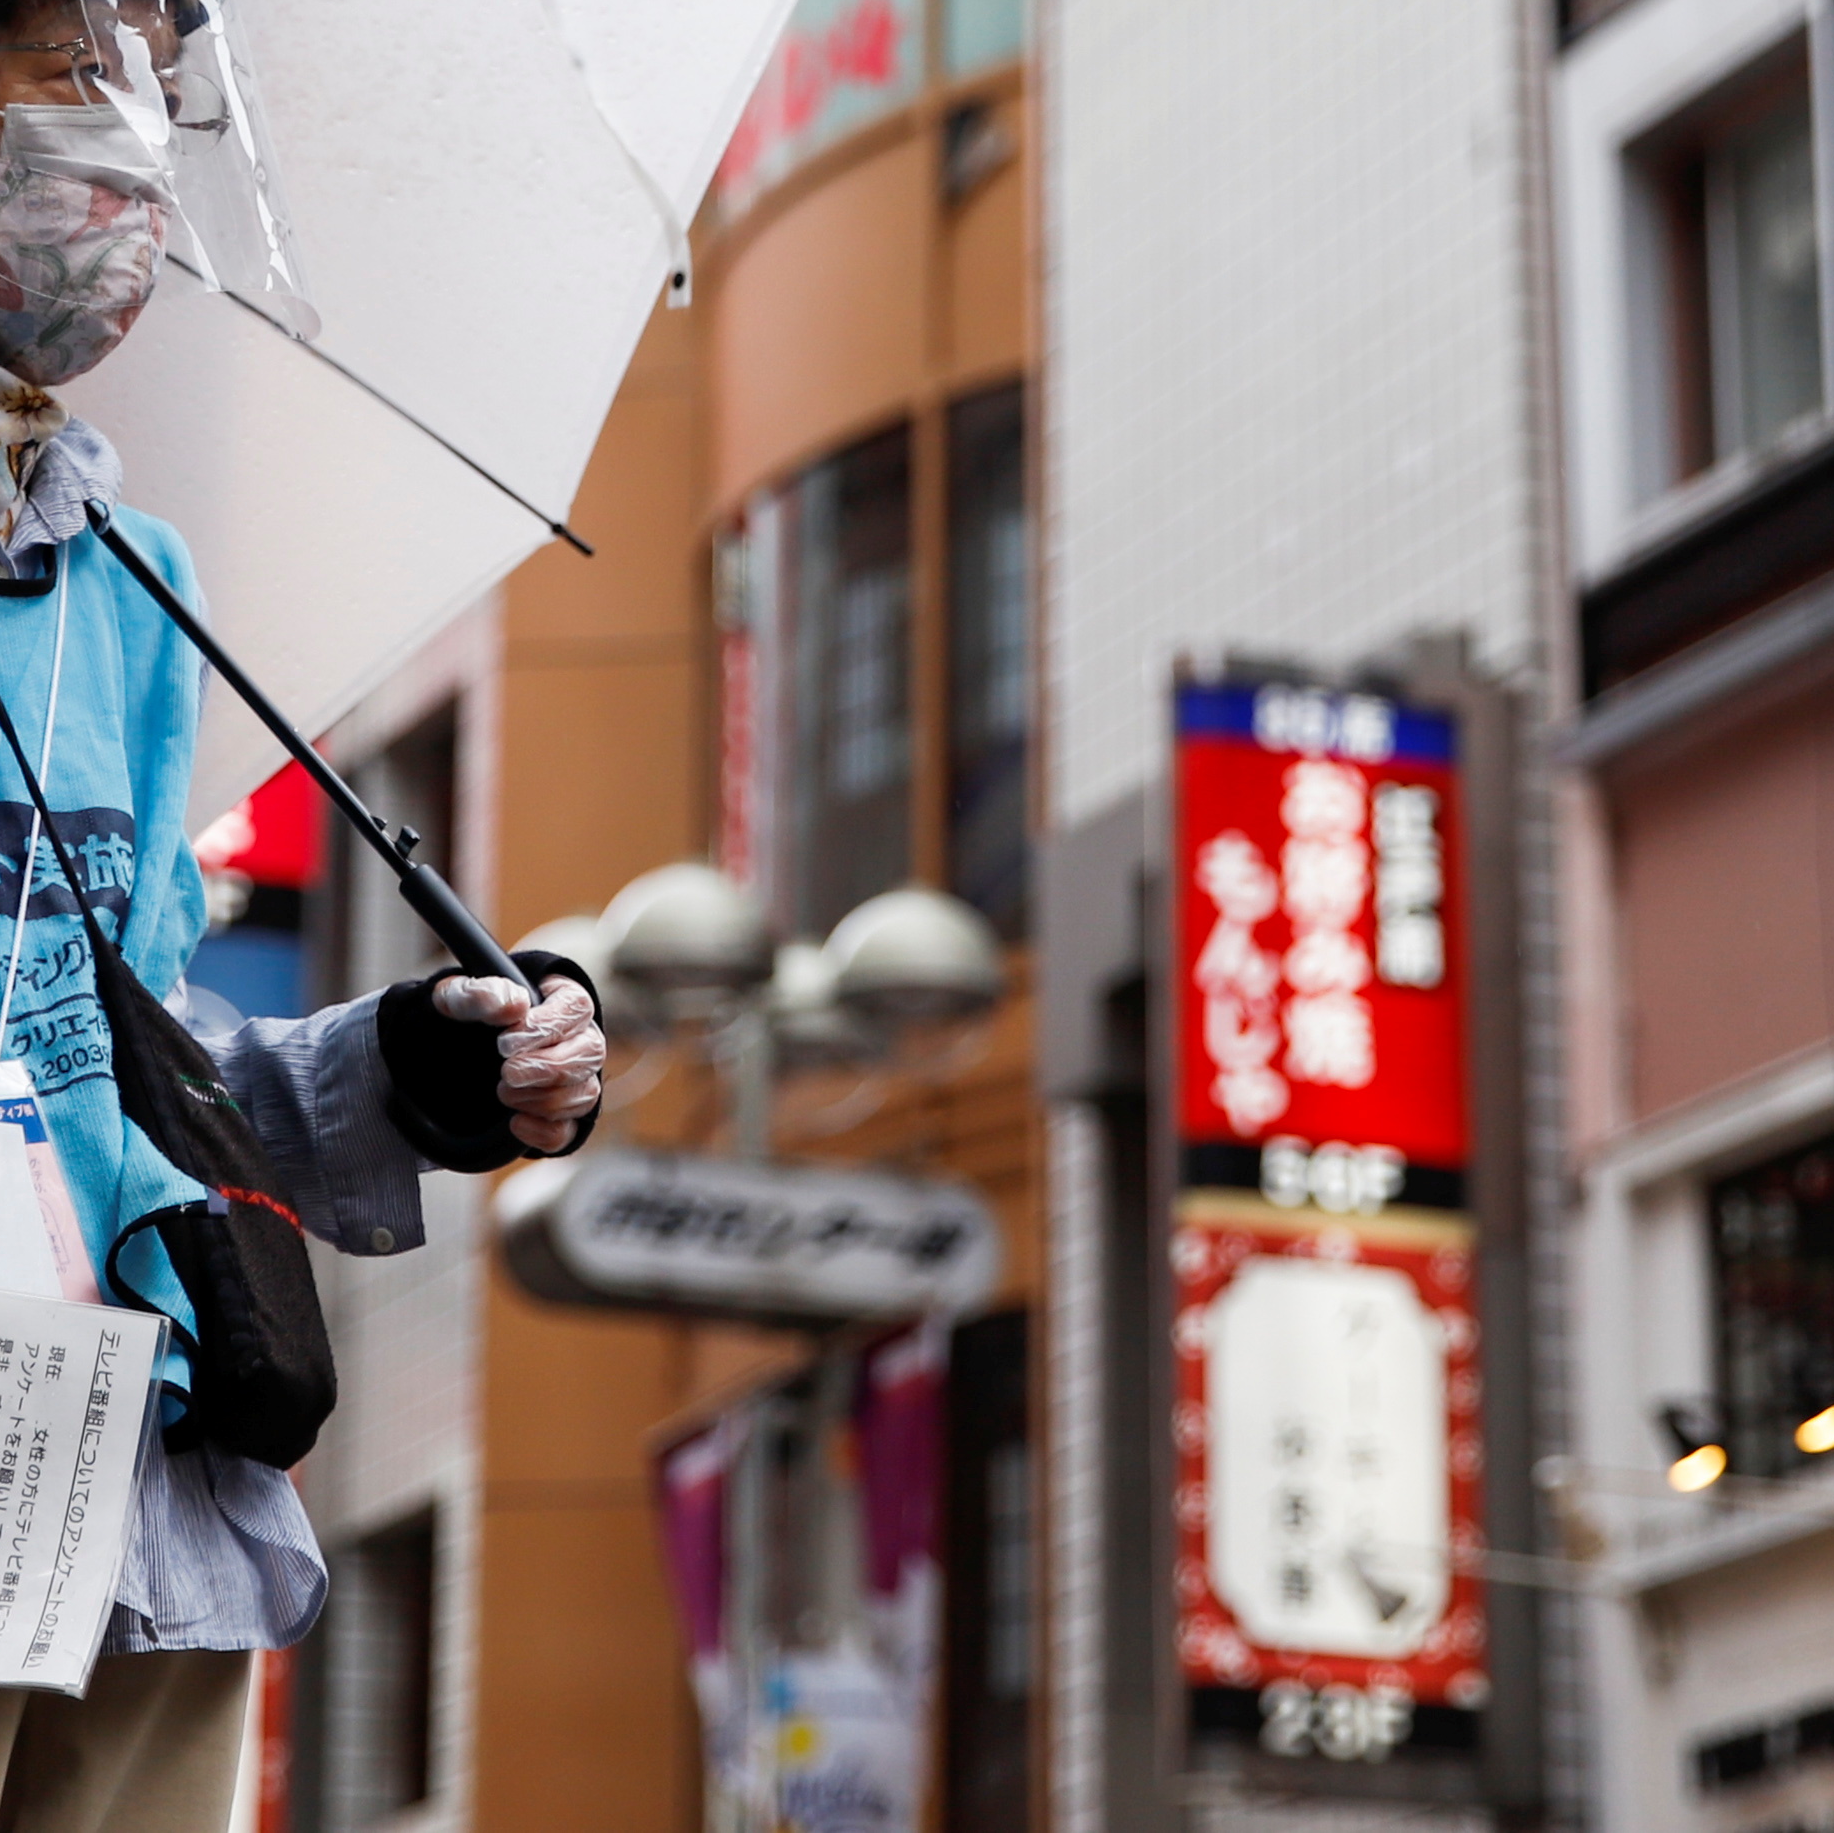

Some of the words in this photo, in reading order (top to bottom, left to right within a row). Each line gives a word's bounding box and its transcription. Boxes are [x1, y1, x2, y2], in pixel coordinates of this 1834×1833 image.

[25, 1328, 124, 1671] テレビ番組についてのアンケートのお願い
